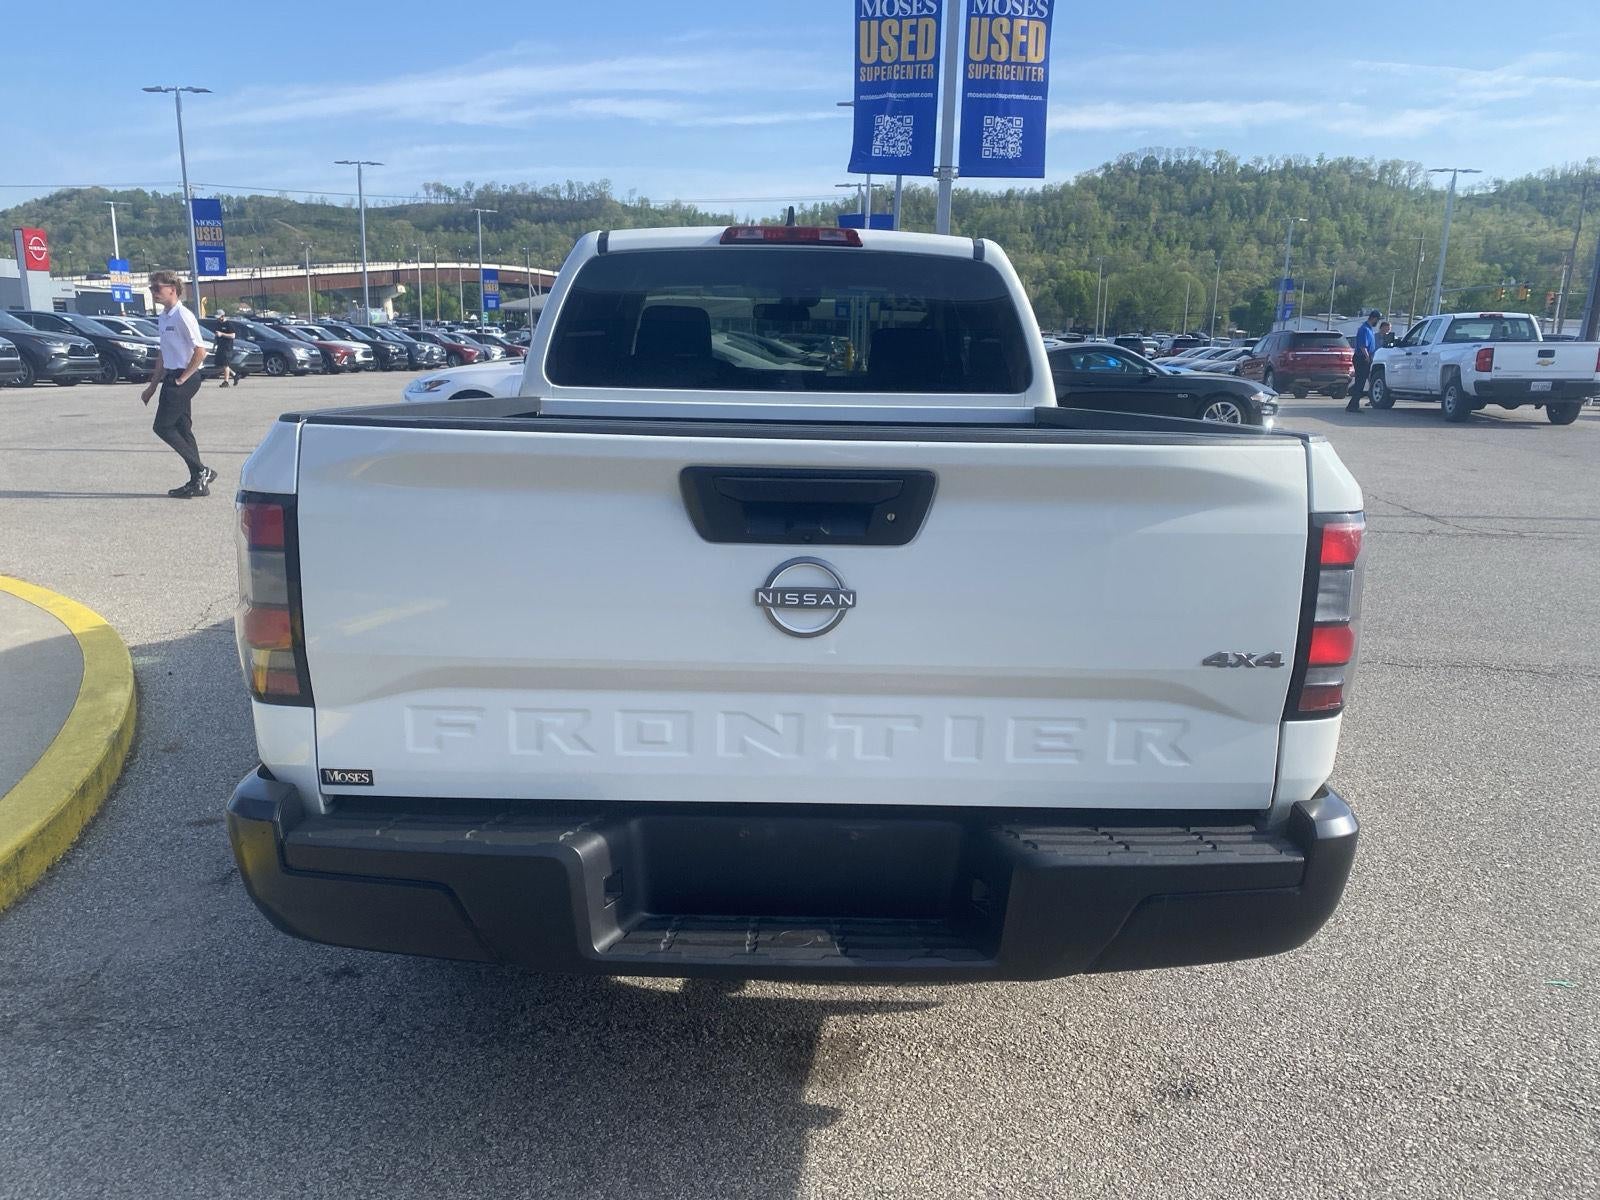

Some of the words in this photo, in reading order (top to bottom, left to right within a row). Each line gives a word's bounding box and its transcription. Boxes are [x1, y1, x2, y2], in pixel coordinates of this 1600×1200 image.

[860, 0, 937, 18] MOSES
[972, 0, 1049, 18] MOSES
[859, 17, 937, 64] USED
[968, 17, 1047, 64] USED
[860, 64, 934, 82] SUPERCENTER
[968, 63, 1045, 82] SUPERCENTER
[195, 226, 223, 241] USED
[758, 591, 853, 606] NISSAN
[404, 703, 1195, 767] FRONTIER
[325, 770, 370, 784] MOSES
